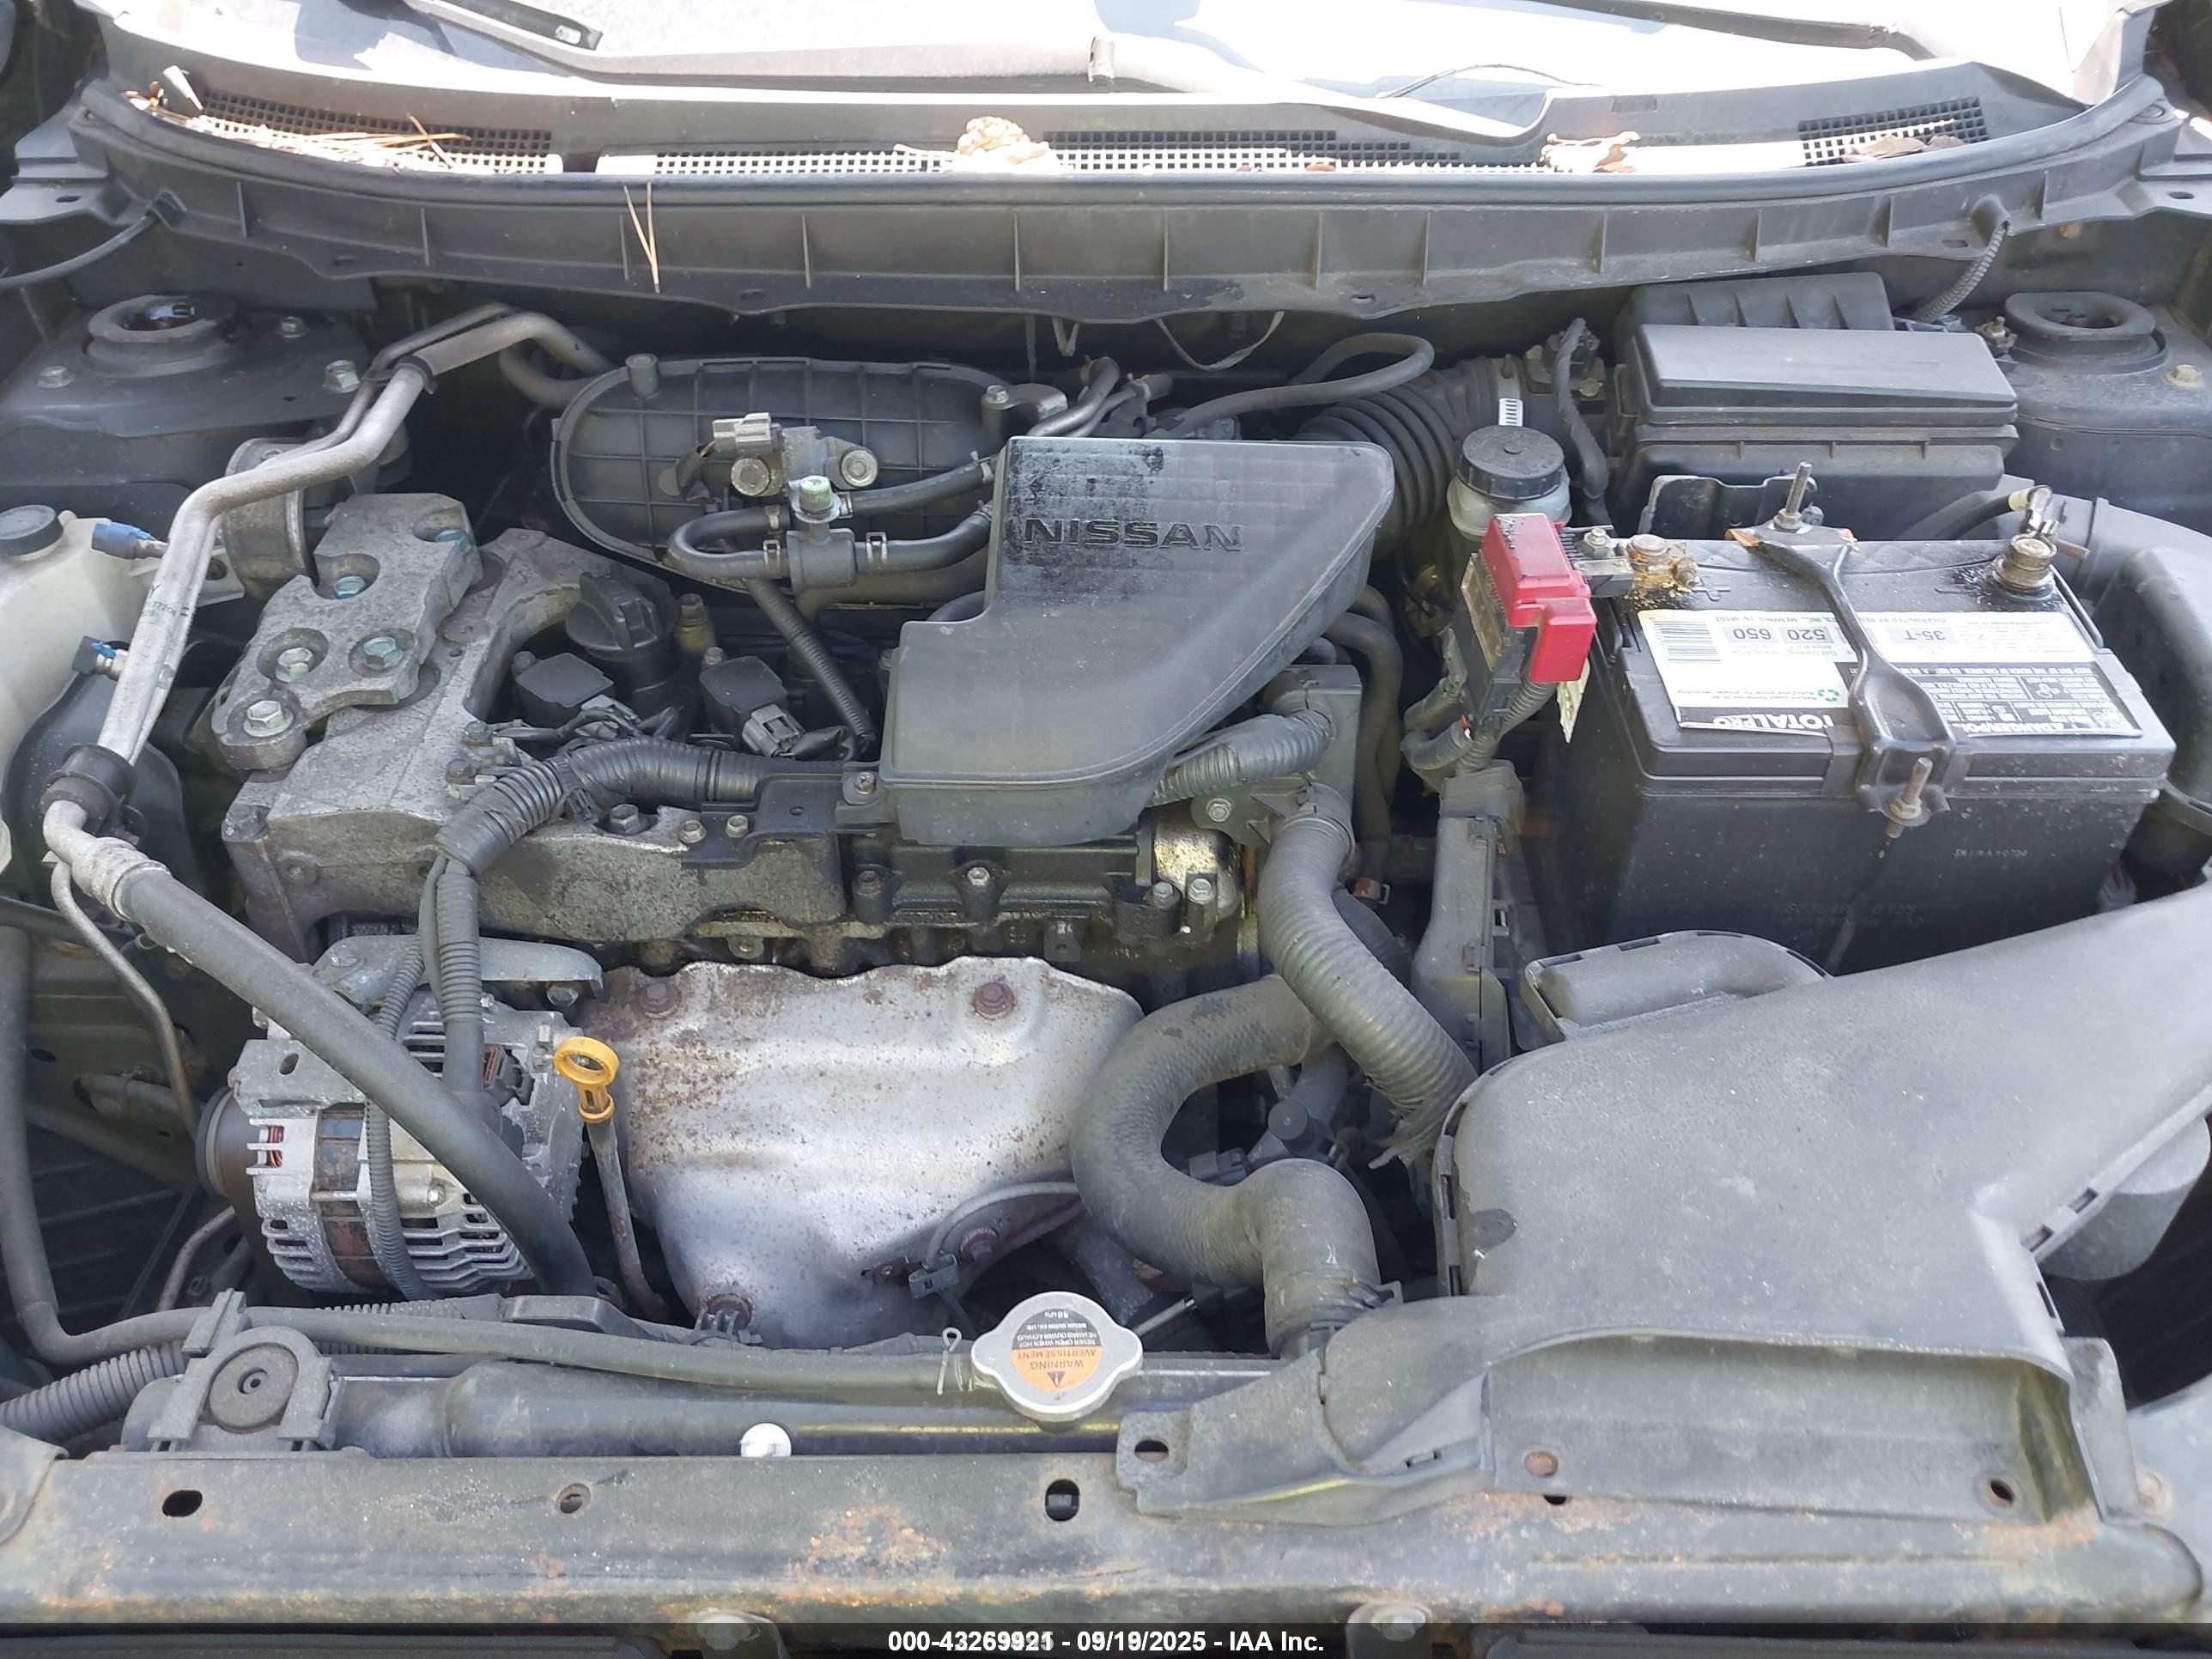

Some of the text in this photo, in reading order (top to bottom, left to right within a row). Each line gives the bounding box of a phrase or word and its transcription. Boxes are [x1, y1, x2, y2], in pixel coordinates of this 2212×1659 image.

[1024, 519, 1242, 551] NISSAN
[1733, 628, 1771, 640] 650
[1787, 628, 1826, 641] 520
[1904, 629, 1946, 641] 35-T
[1016, 1348, 1097, 1360] AVERTISSEMENT
[1030, 1359, 1085, 1370] WARNING
